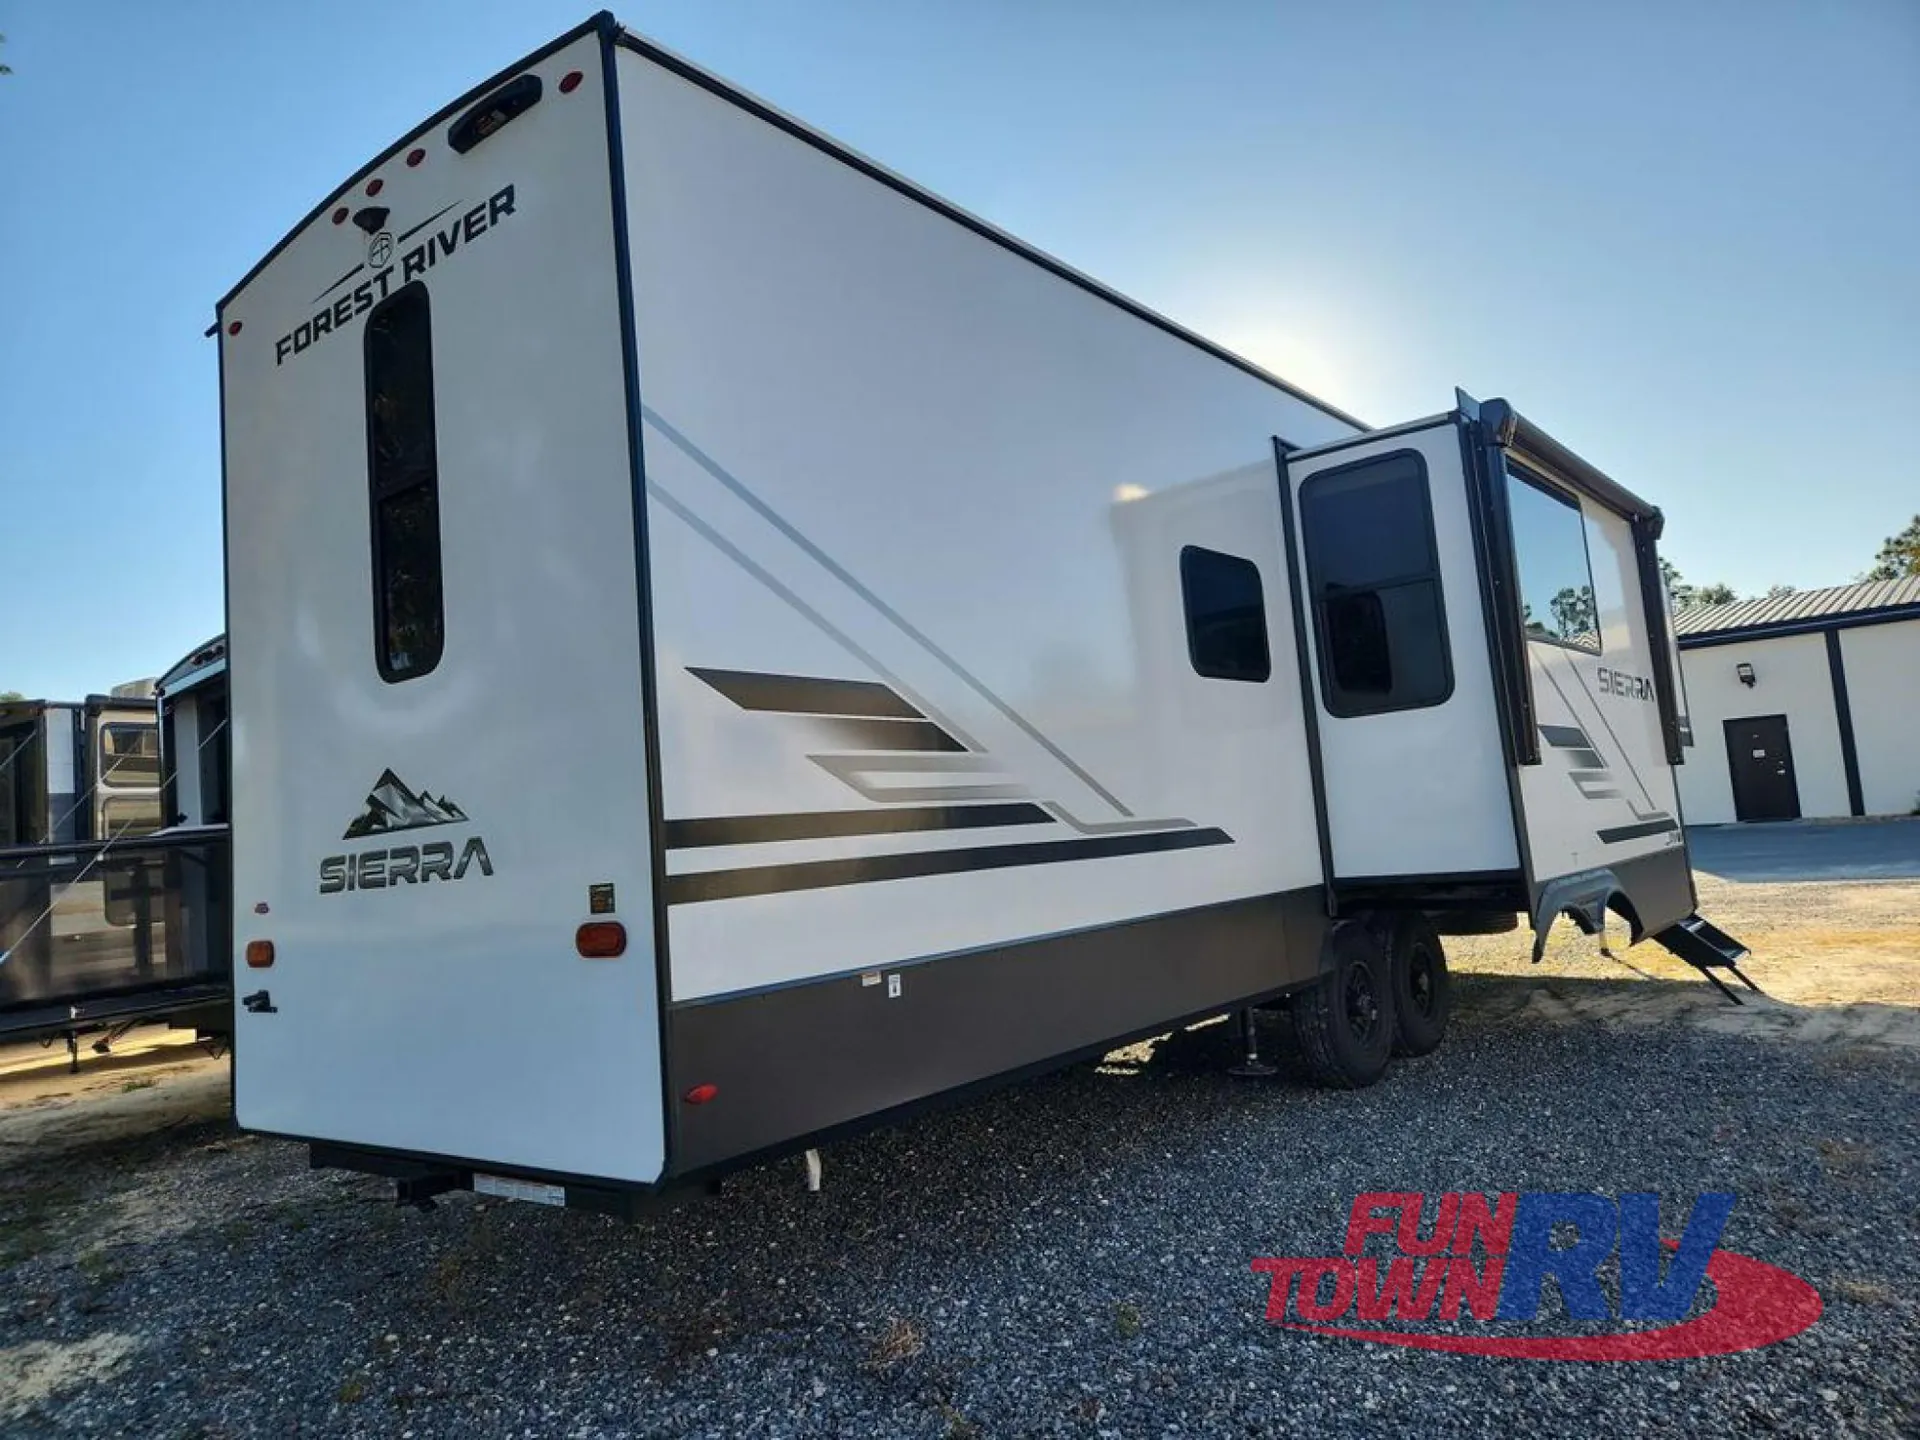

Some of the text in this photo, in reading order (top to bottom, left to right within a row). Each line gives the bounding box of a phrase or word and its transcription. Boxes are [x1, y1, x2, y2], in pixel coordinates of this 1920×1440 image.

[275, 184, 517, 367] FOREST RIVER
[1597, 667, 1655, 702] SIERRA
[320, 837, 494, 895] SIERRA
